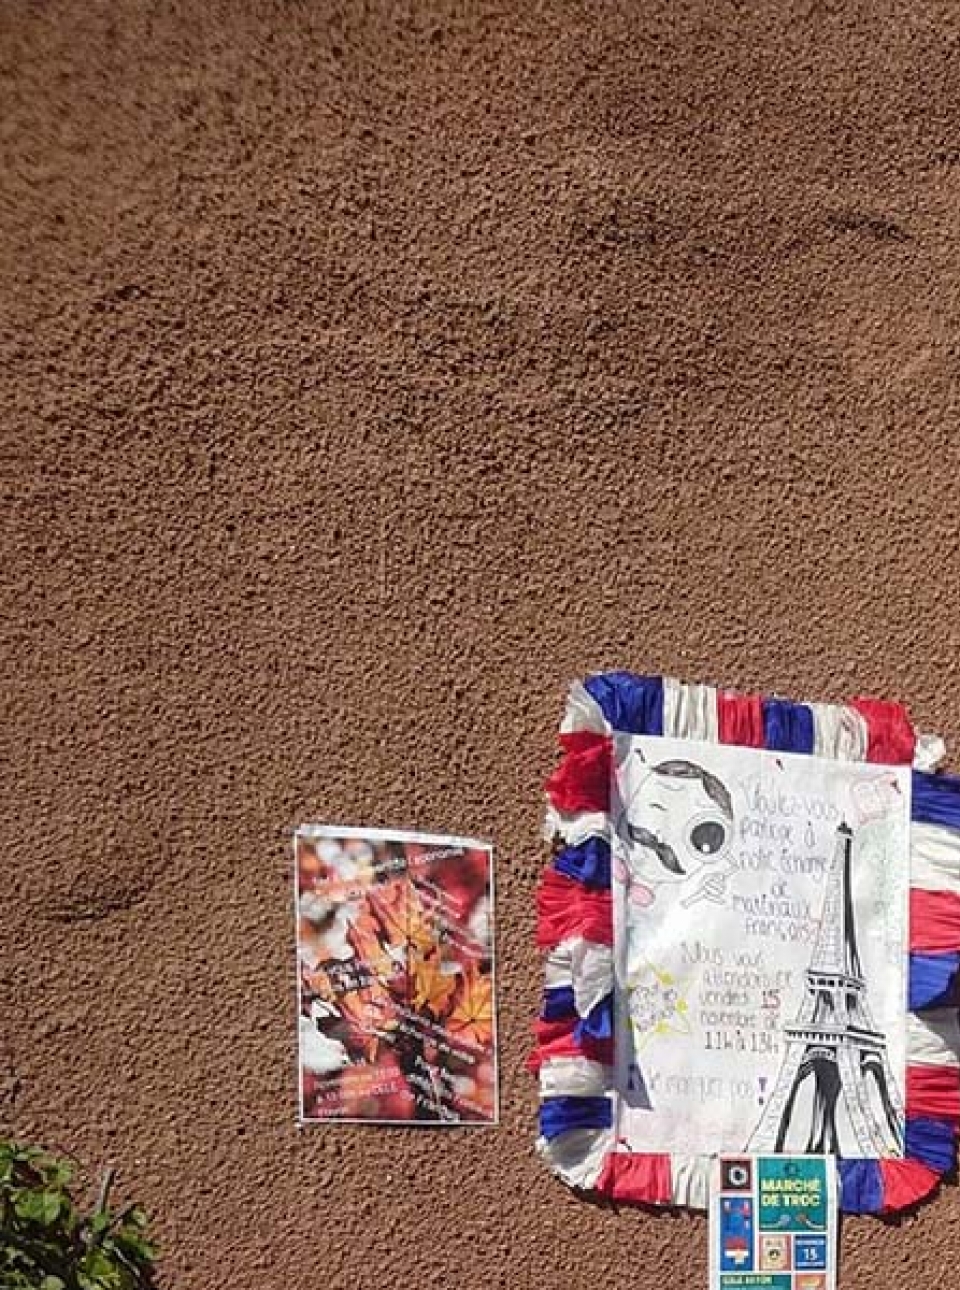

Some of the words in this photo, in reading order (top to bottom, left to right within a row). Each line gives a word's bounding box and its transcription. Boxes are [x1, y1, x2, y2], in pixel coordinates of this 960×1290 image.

[761, 988, 780, 1009] 15
[761, 1178, 821, 1193] MARCHÉ
[761, 1193, 781, 1207] DE
[783, 1193, 820, 1207] TROC
